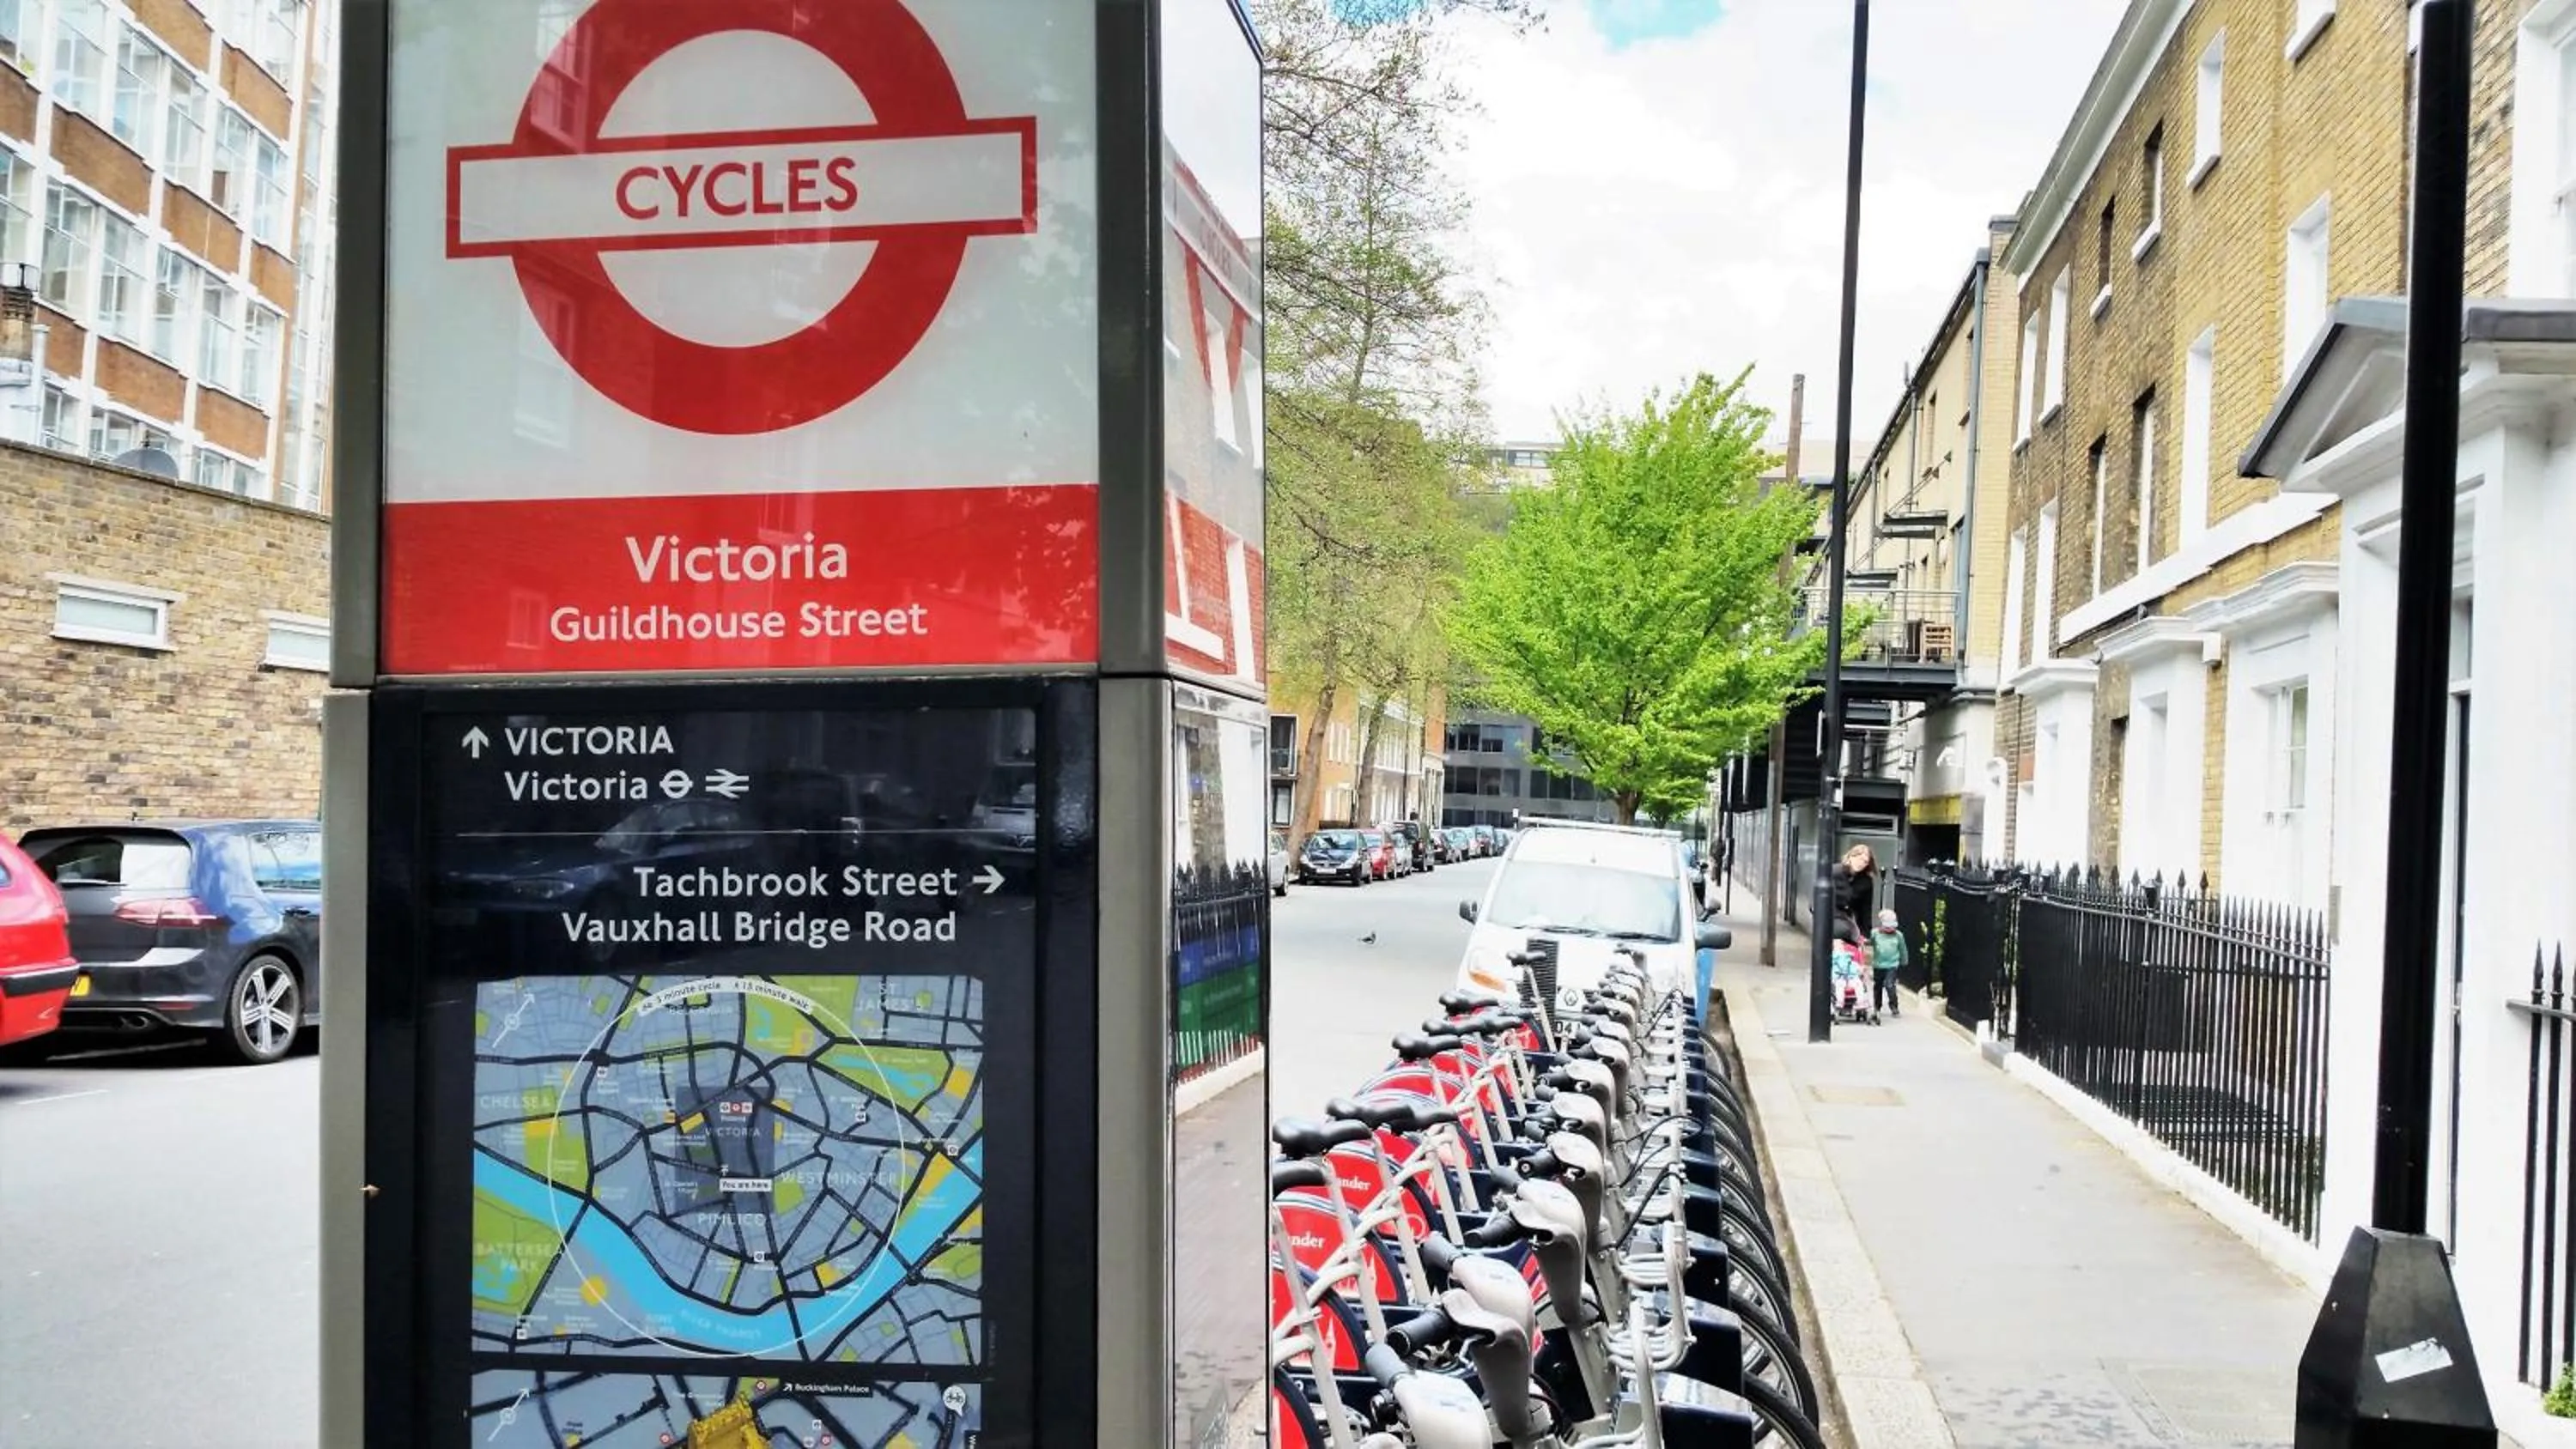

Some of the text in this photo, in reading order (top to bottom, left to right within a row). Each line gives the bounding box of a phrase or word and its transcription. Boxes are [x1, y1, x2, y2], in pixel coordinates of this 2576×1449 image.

[617, 157, 858, 220] CYCLES
[625, 531, 848, 583] Victoria
[550, 602, 928, 642] Guildhouse Street
[505, 725, 674, 755] VICTORIA
[504, 770, 648, 801] Victoria
[633, 864, 957, 897] Tachbrook Street
[562, 911, 956, 949] Vauxhall Bridge Road
